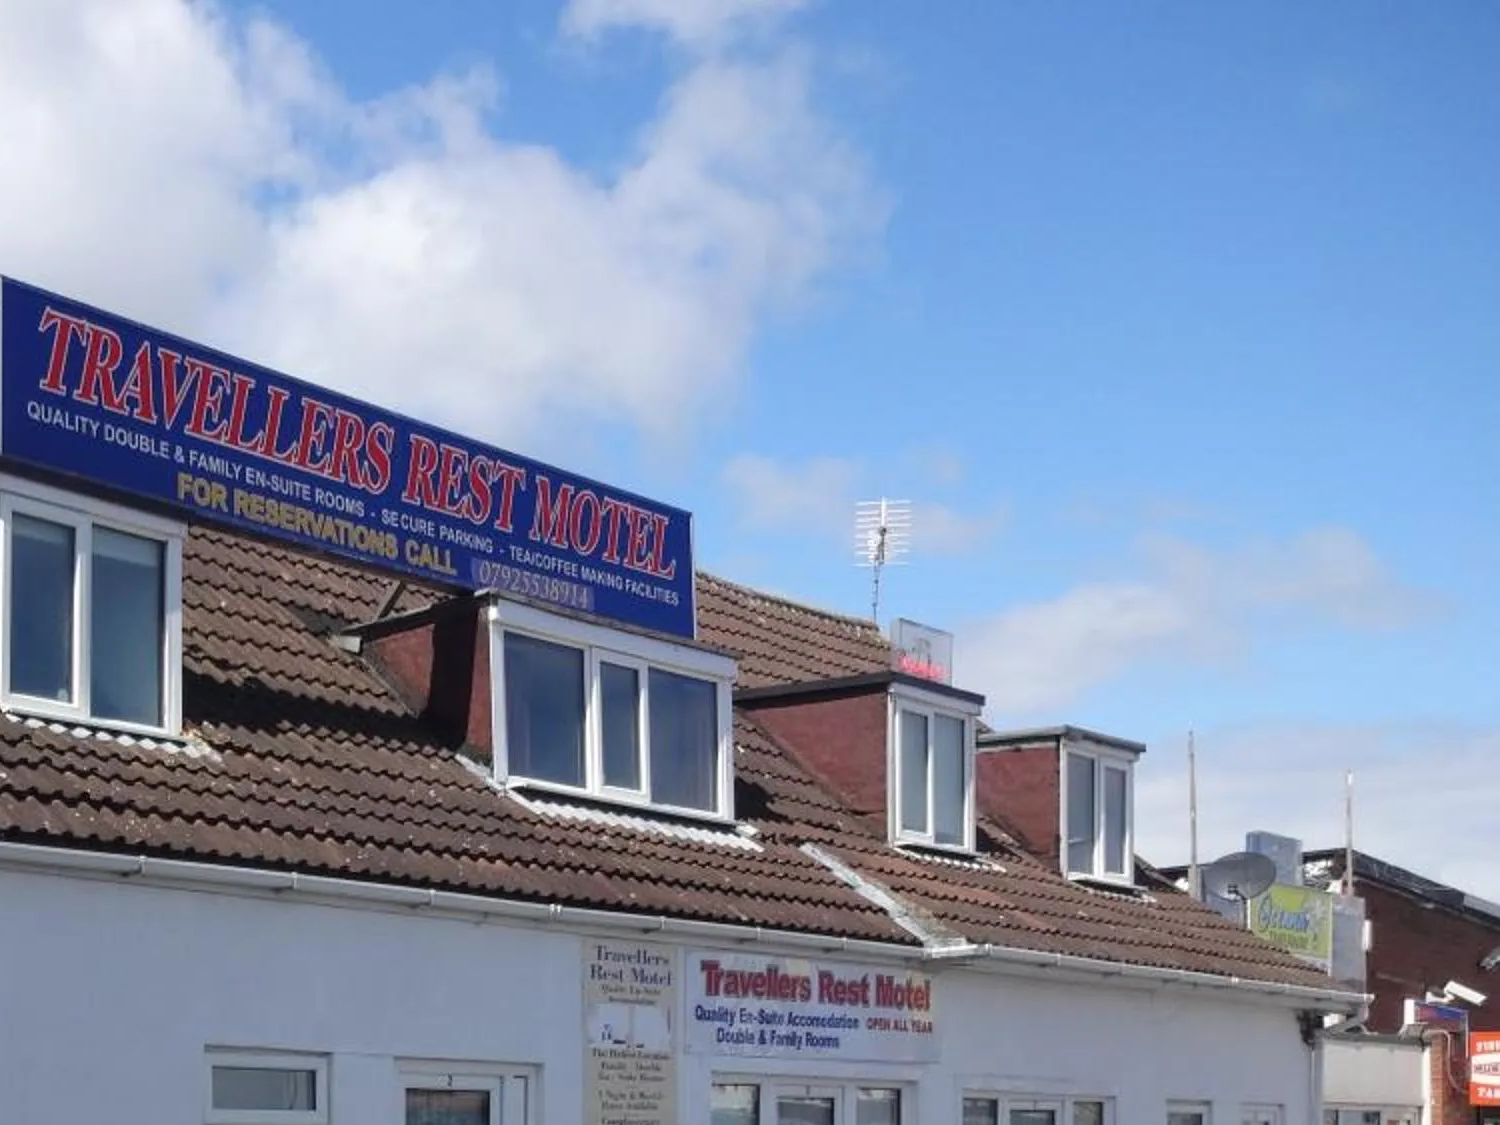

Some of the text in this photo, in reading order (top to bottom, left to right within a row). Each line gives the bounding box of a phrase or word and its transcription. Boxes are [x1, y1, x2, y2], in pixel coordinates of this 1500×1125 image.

[38, 306, 677, 580] TRAVELLERS REST MOTEL
[27, 401, 100, 437] QUALITY
[104, 424, 170, 460] DOUBLE
[174, 445, 185, 463] &
[189, 450, 243, 480] FAMILY
[245, 467, 311, 501] EN-SUITE
[315, 488, 365, 517] ROOMS
[381, 508, 436, 538] SECURE
[439, 525, 493, 553] PARKING
[581, 566, 624, 590] MAKING
[624, 578, 679, 606] FACILITIES
[177, 472, 457, 575] FOR RESERVATIONS CALL
[695, 1004, 736, 1027] Quality
[700, 959, 931, 1012] Travellers Rest Motel
[716, 1027, 756, 1045] Double
[770, 1030, 802, 1051] Family
[805, 1032, 840, 1049] Rooms
